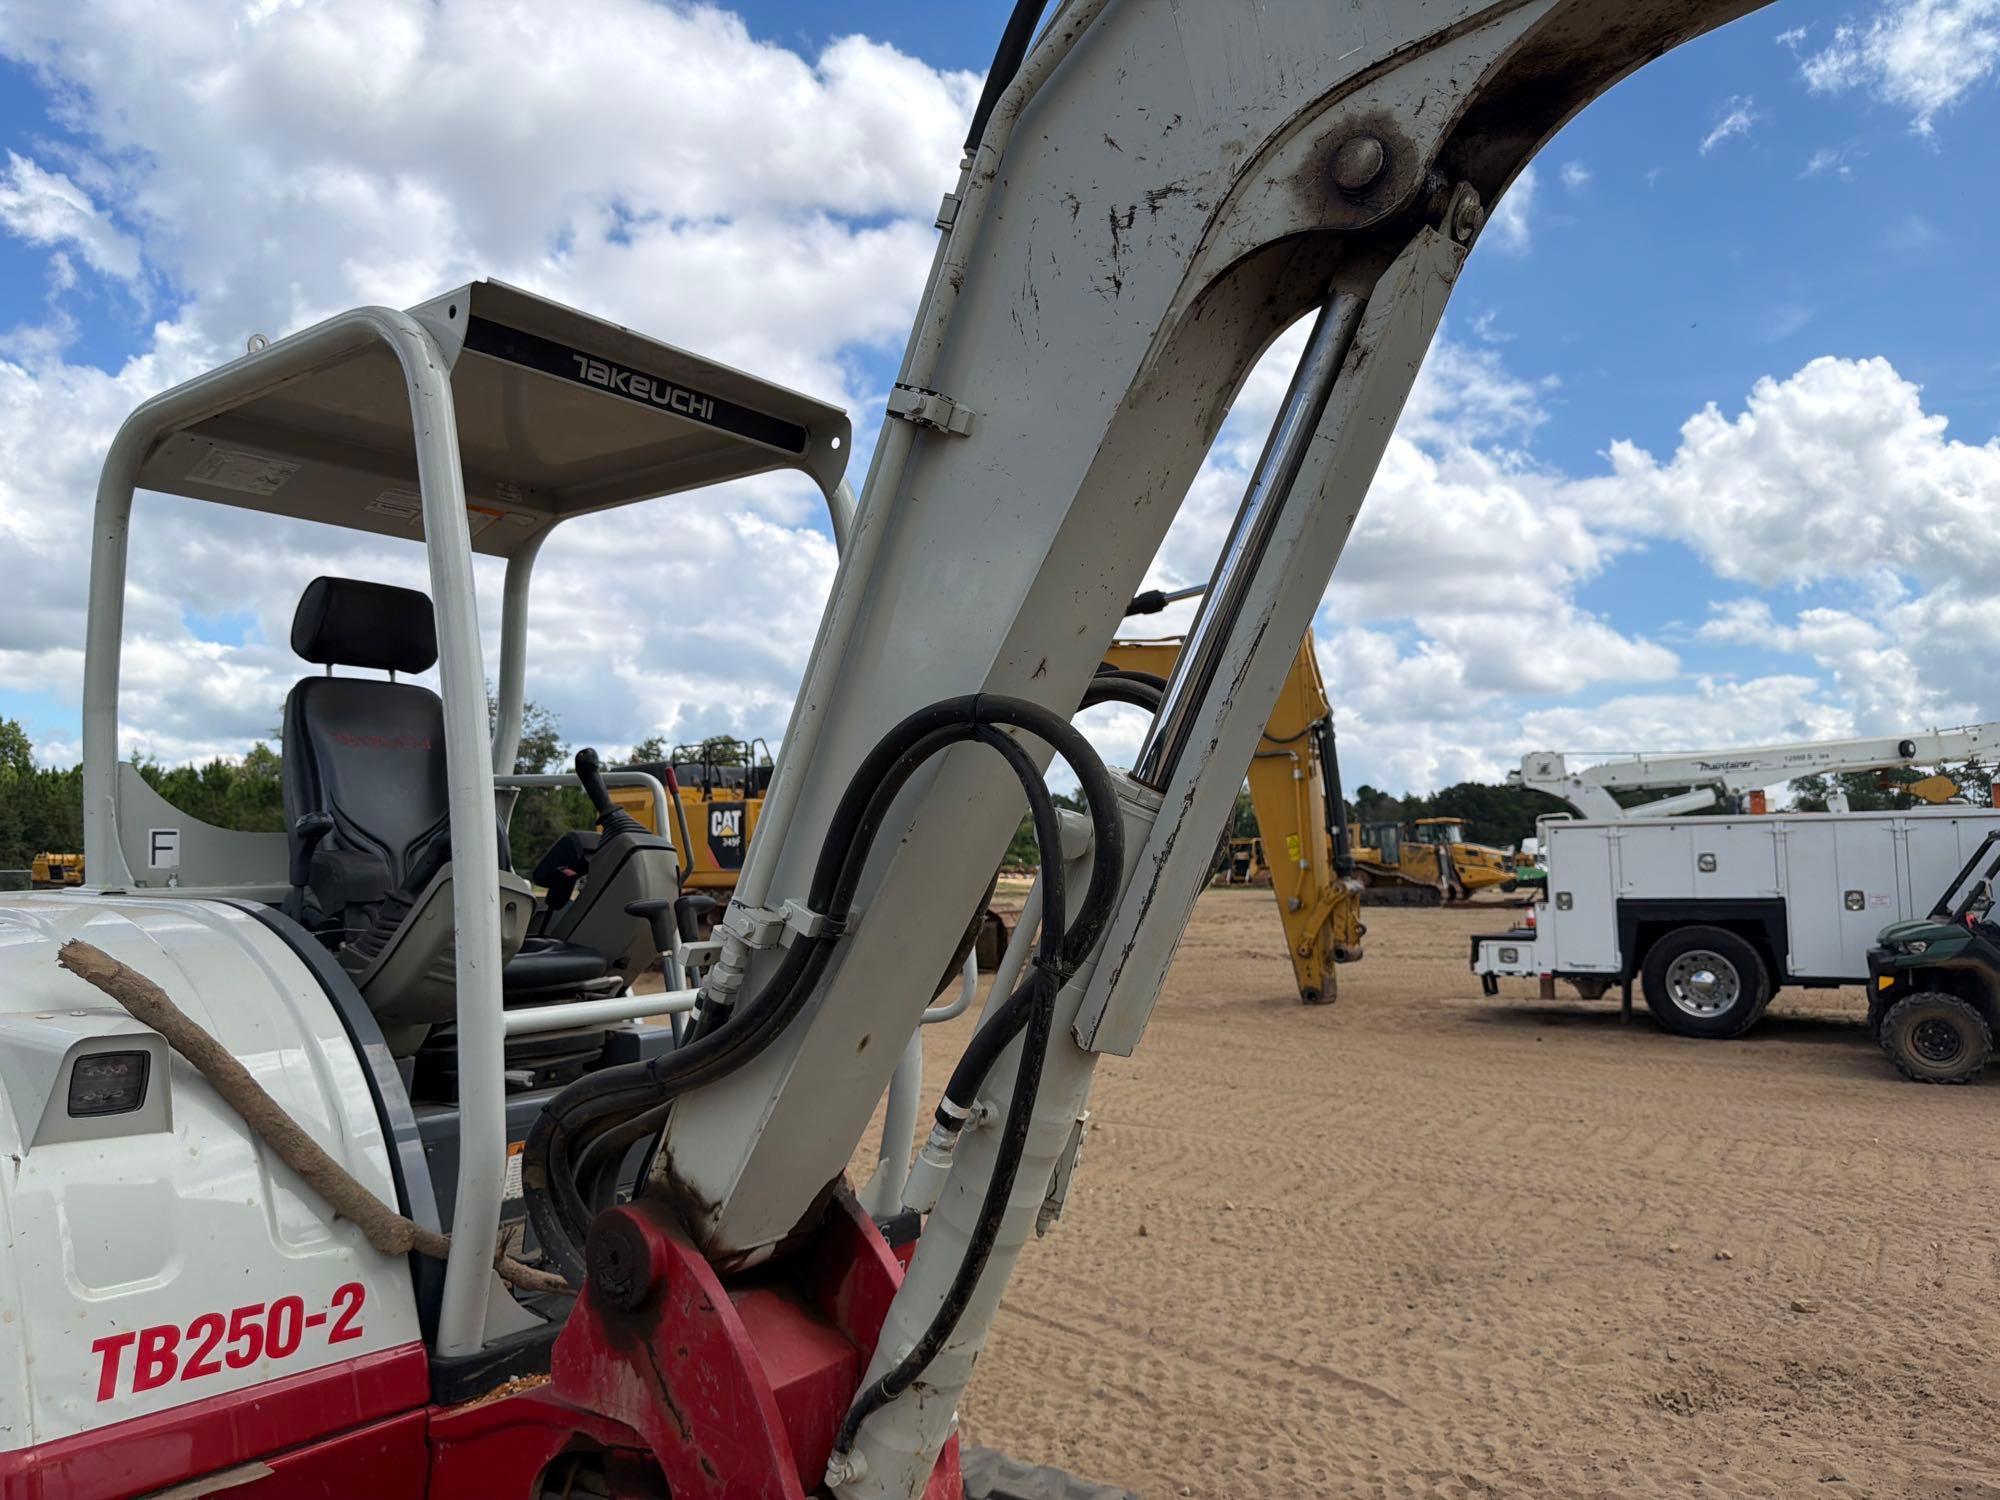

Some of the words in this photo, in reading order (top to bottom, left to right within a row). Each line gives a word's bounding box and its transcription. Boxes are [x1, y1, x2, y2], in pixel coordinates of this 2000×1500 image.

[711, 810, 742, 837] CAT
[152, 831, 178, 866] F
[91, 1281, 366, 1403] TB250-2
